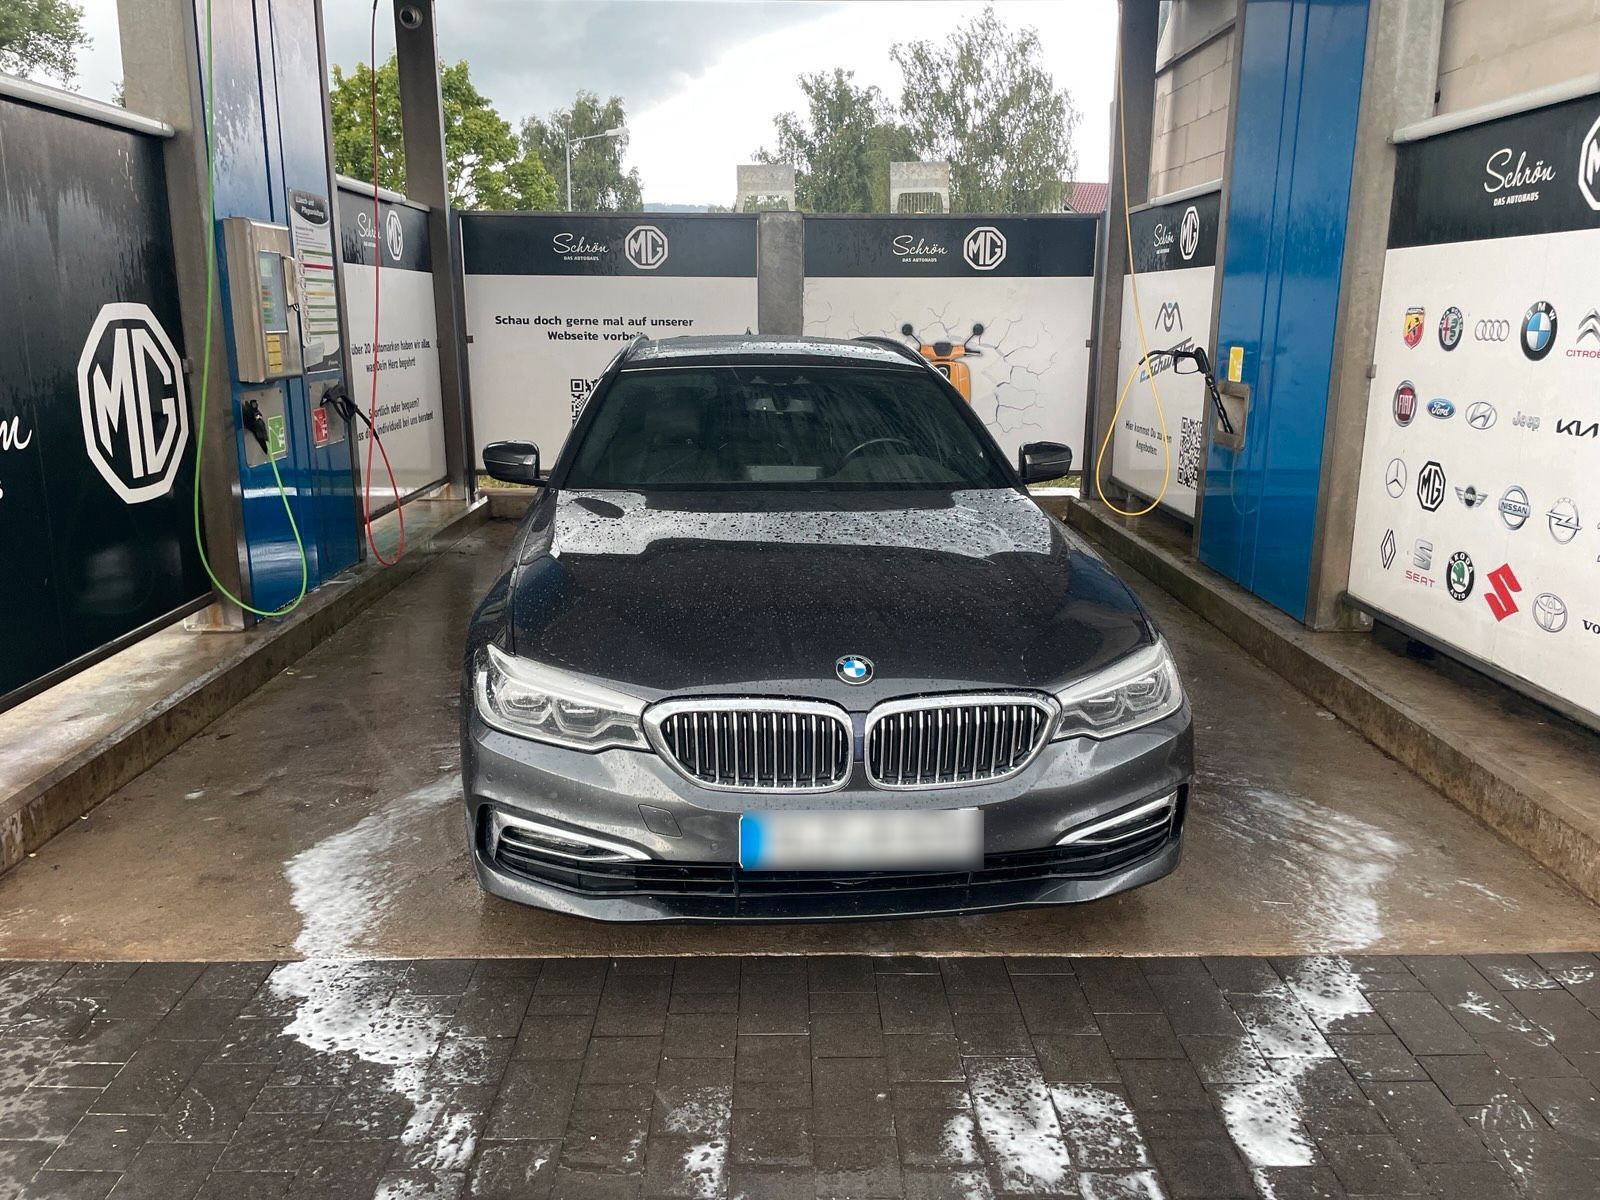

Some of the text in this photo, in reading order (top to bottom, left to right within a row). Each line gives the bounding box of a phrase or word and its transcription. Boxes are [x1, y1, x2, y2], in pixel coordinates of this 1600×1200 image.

[1484, 148, 1556, 192] Schrön
[1493, 192, 1539, 206] DAS AUTOHAUS
[553, 233, 609, 253] Schrön
[630, 230, 663, 264] MG
[892, 235, 948, 255] Schrön
[968, 232, 1001, 264] MG
[495, 315, 530, 325] Schau
[533, 316, 562, 326] doch
[566, 317, 599, 327] gerne
[603, 317, 624, 326] mal
[628, 317, 647, 326] auf
[1526, 302, 1557, 320] BMW
[547, 331, 599, 341] Webseite
[93, 328, 177, 479] MG
[1398, 394, 1413, 415] FIAT
[1432, 401, 1450, 416] Ford
[1512, 410, 1540, 431] Jeep
[1421, 468, 1442, 505] MG
[1502, 502, 1528, 514] NISSAN
[1405, 570, 1436, 588] SEAT
[1450, 588, 1466, 600] AUTO
